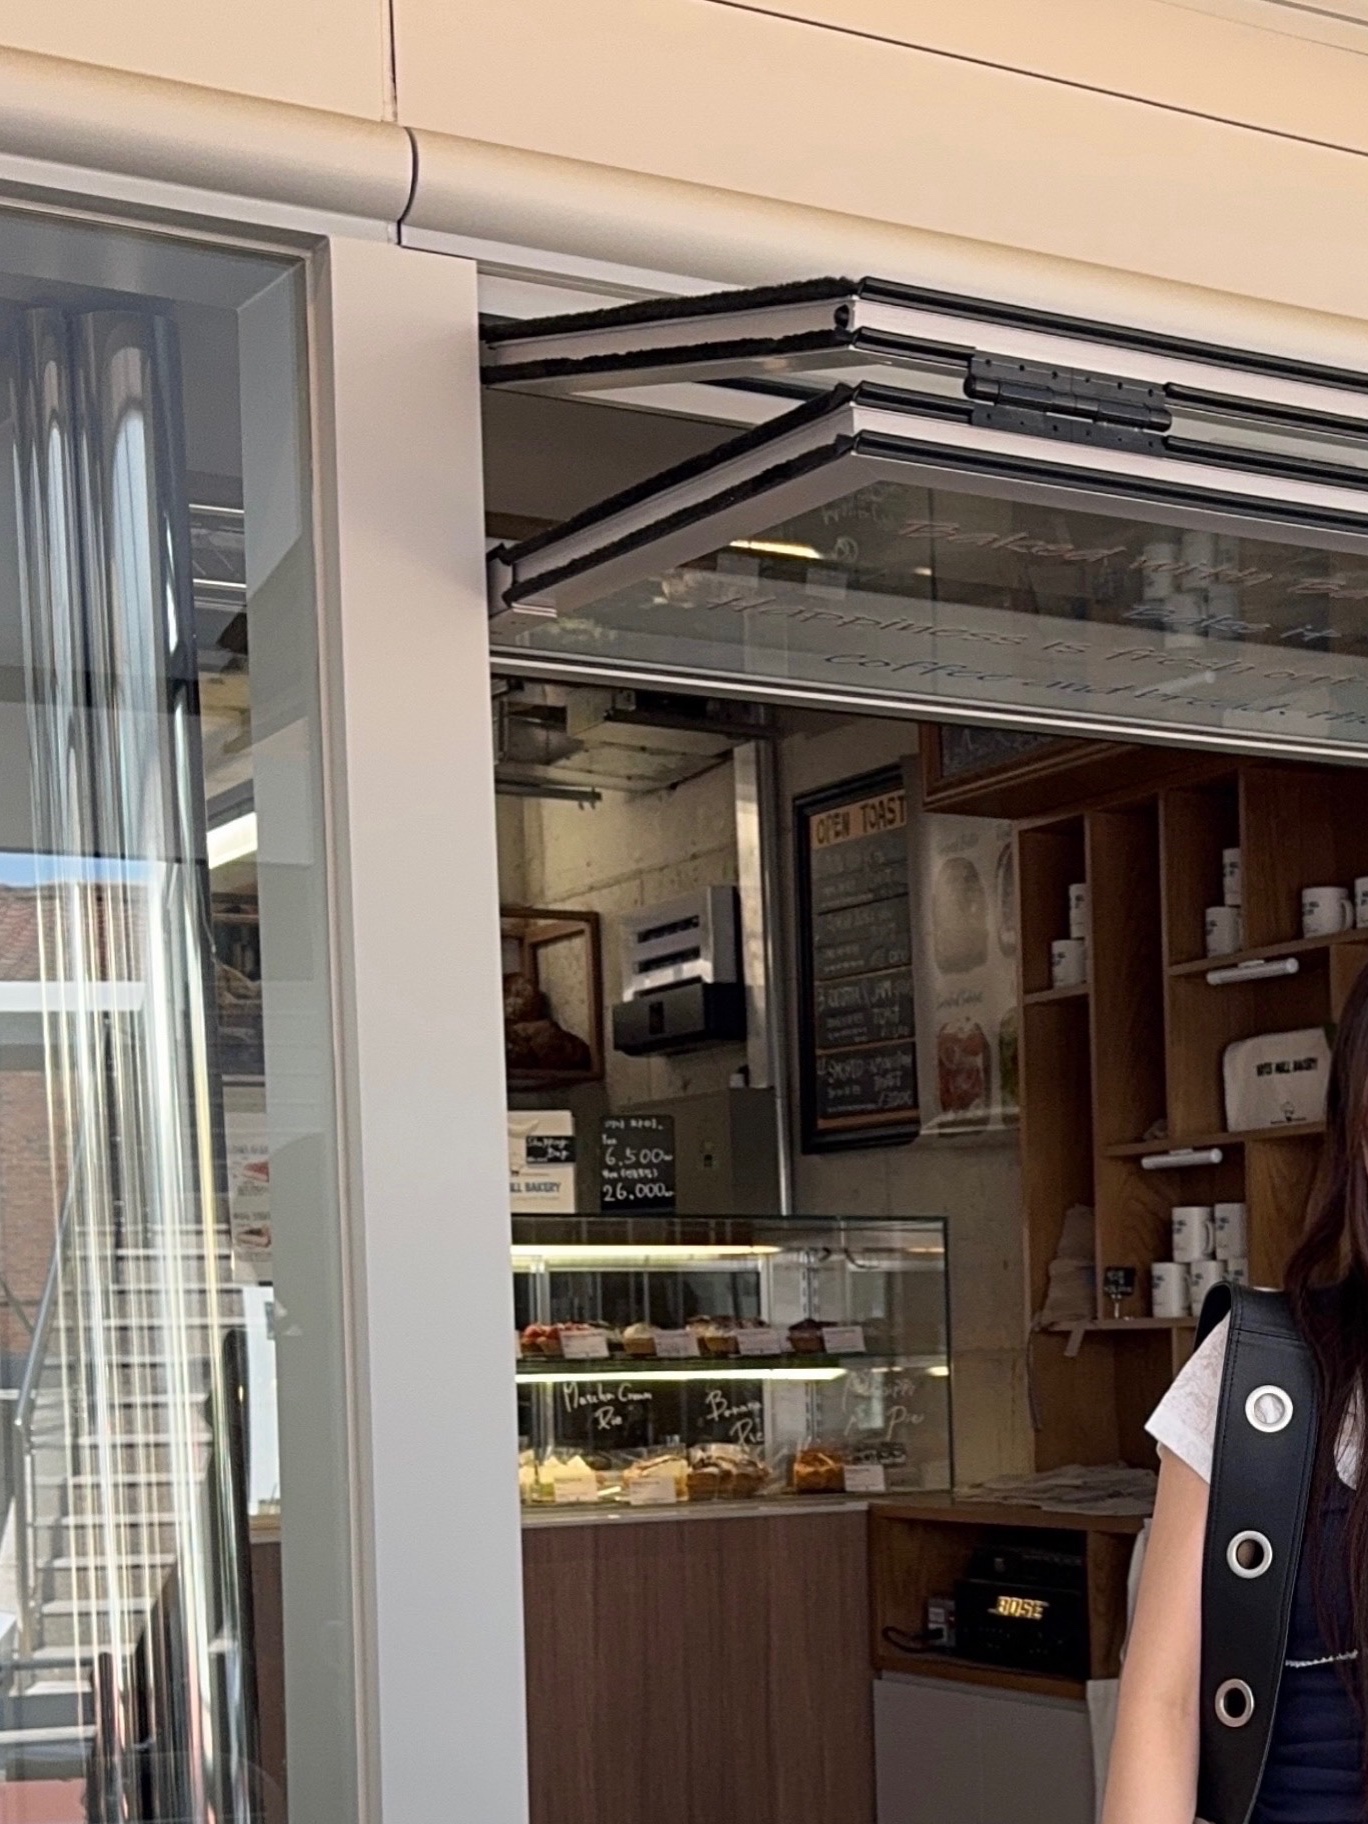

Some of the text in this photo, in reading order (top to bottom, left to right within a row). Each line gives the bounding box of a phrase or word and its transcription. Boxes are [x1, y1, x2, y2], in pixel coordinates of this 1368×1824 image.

[899, 519, 1126, 561] Baked
[706, 596, 1028, 648] Happiness
[1105, 646, 1255, 675] fresh
[816, 795, 906, 844] OPEN TOAST
